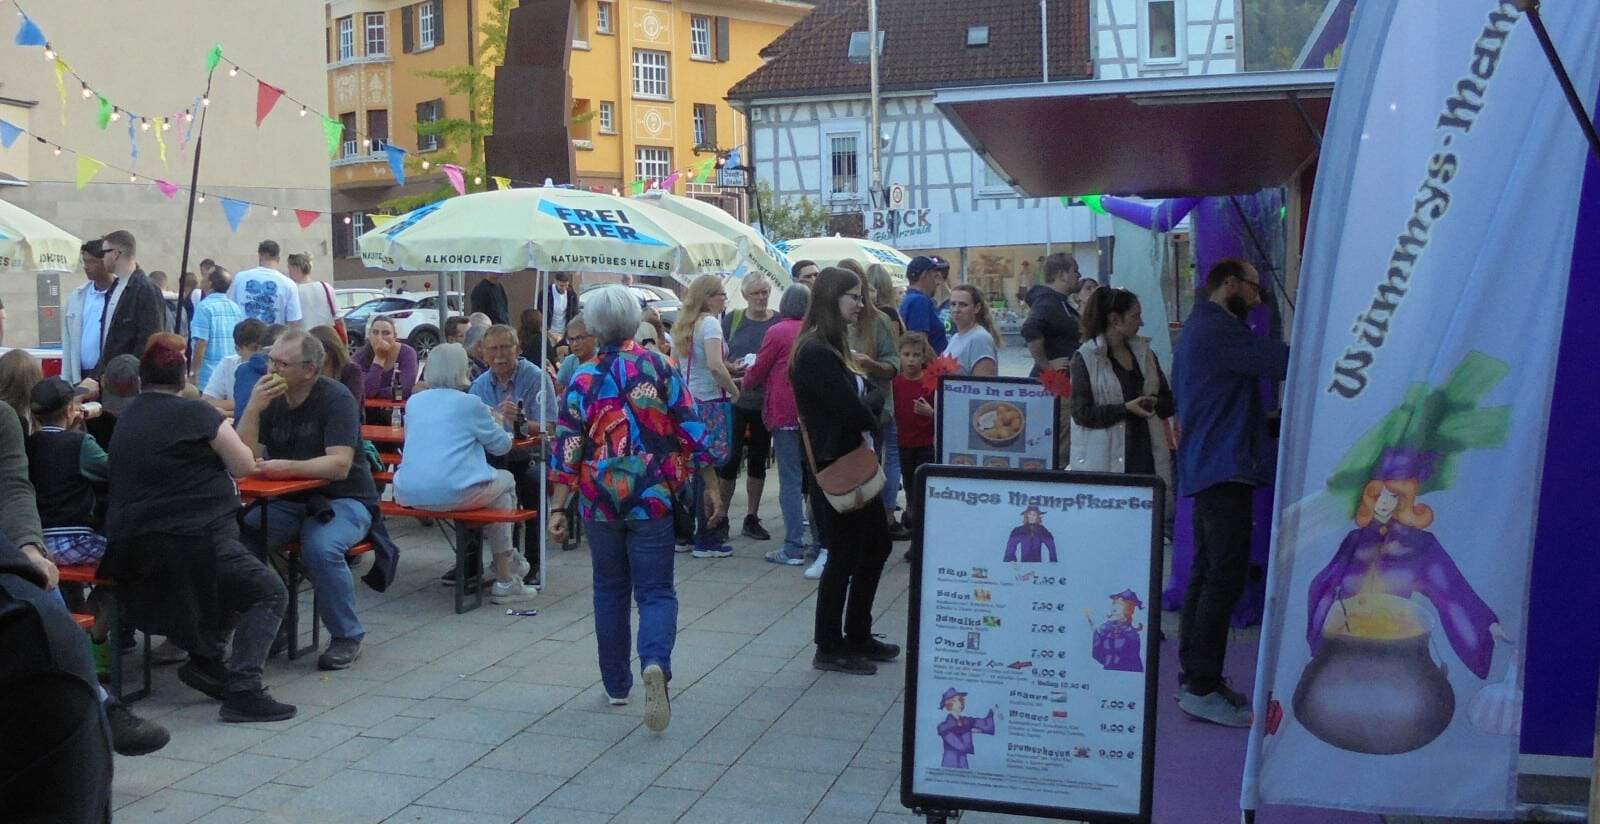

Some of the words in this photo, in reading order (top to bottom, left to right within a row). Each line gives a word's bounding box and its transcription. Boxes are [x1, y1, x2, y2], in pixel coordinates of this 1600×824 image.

[554, 207, 630, 224] FREI
[563, 222, 640, 241] BIER
[425, 255, 502, 265] ALKOHOLFREI
[551, 254, 627, 266] NATURTRÜBES
[630, 259, 670, 271] HELLES
[944, 383, 981, 395] Balls
[986, 386, 1000, 397] in
[1004, 389, 1015, 397] a
[1008, 491, 1153, 511] Mampfkarte
[934, 636, 965, 648] Oma
